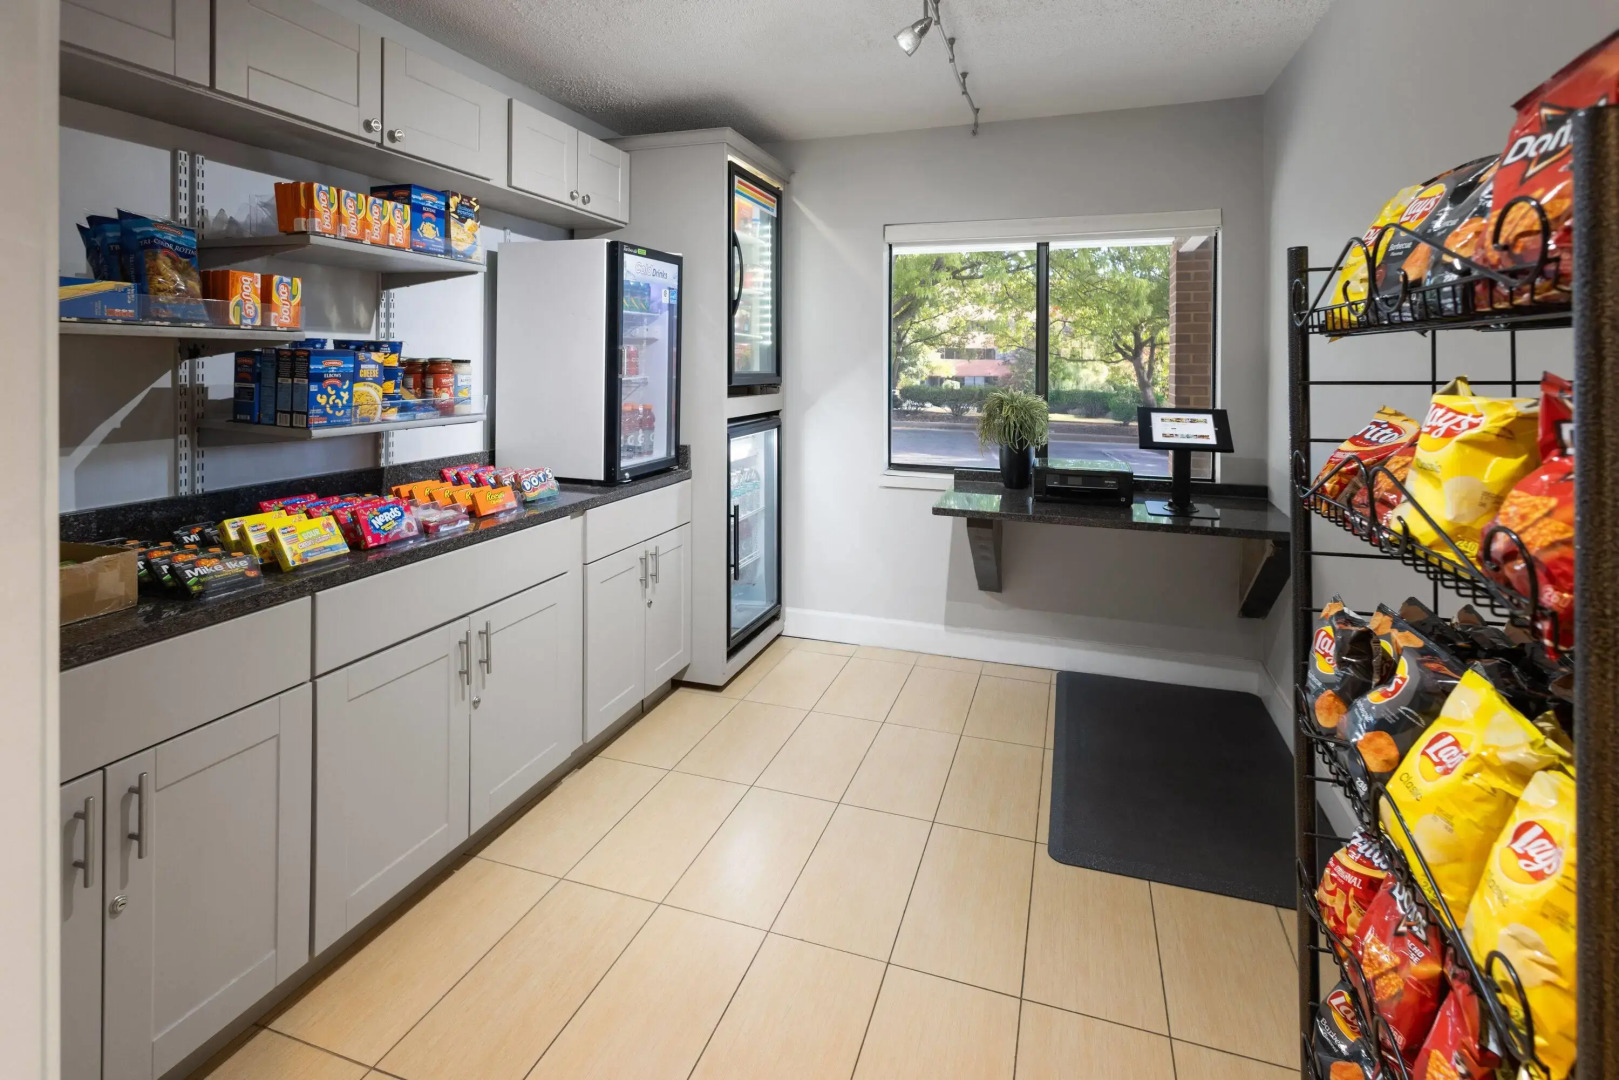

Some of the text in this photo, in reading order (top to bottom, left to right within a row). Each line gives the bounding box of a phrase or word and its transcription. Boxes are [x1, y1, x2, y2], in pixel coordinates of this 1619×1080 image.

[1502, 118, 1574, 166] Dori
[319, 190, 332, 229] bounce
[346, 197, 358, 235] bounce
[371, 204, 380, 240] bounce
[394, 209, 404, 244] bounce
[652, 268, 668, 280] Drinks
[241, 276, 255, 318] bounce
[279, 283, 291, 323] bounce
[359, 369, 379, 378] CHEESE
[522, 467, 553, 492] DOTS
[184, 564, 224, 579] Mike
[227, 559, 249, 569] Ike
[1333, 865, 1363, 890] ORIGINAL
[1406, 939, 1425, 958] ACHO
